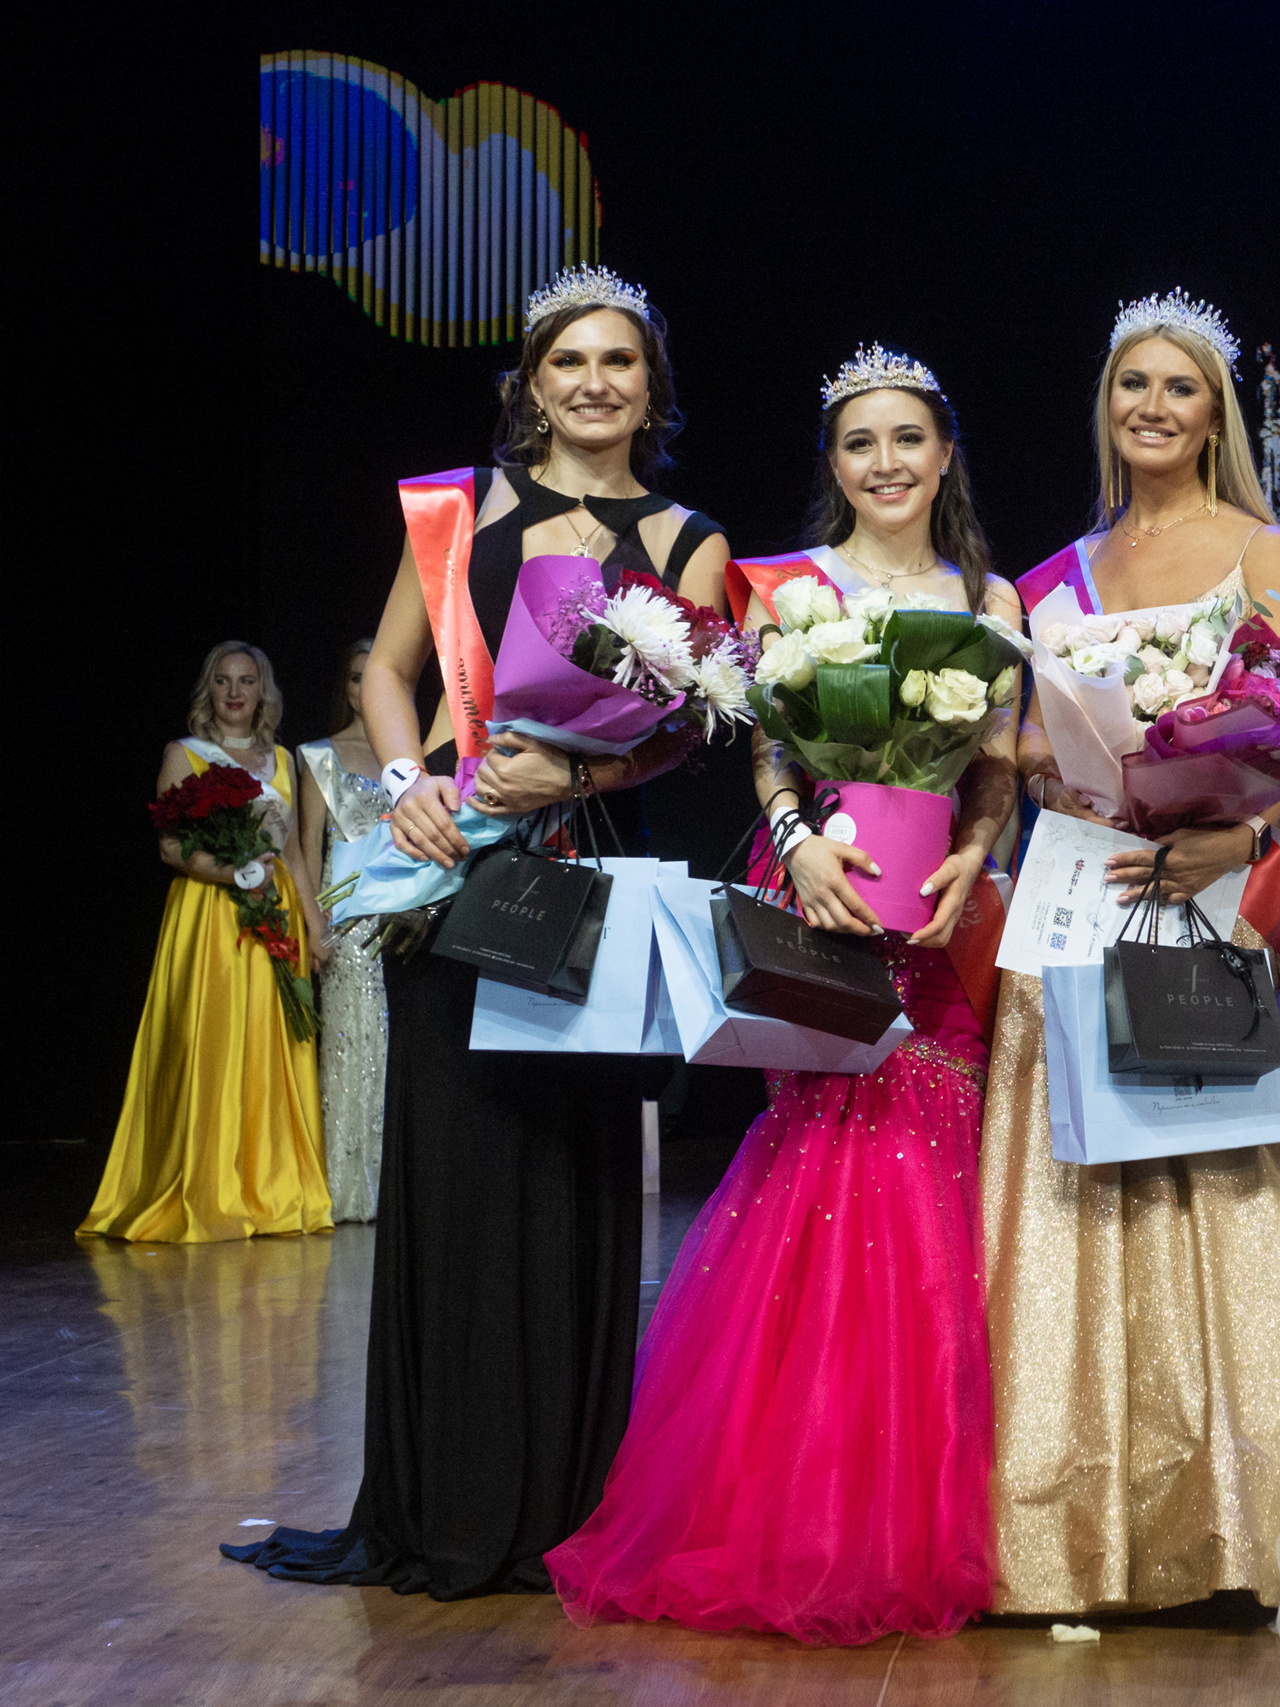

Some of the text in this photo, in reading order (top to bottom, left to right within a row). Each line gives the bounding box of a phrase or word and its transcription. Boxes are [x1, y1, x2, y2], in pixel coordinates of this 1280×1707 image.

[490, 900, 546, 921] PEOPLE
[776, 936, 841, 963] PEOPLE
[1167, 993, 1235, 1007] PEOPLE
